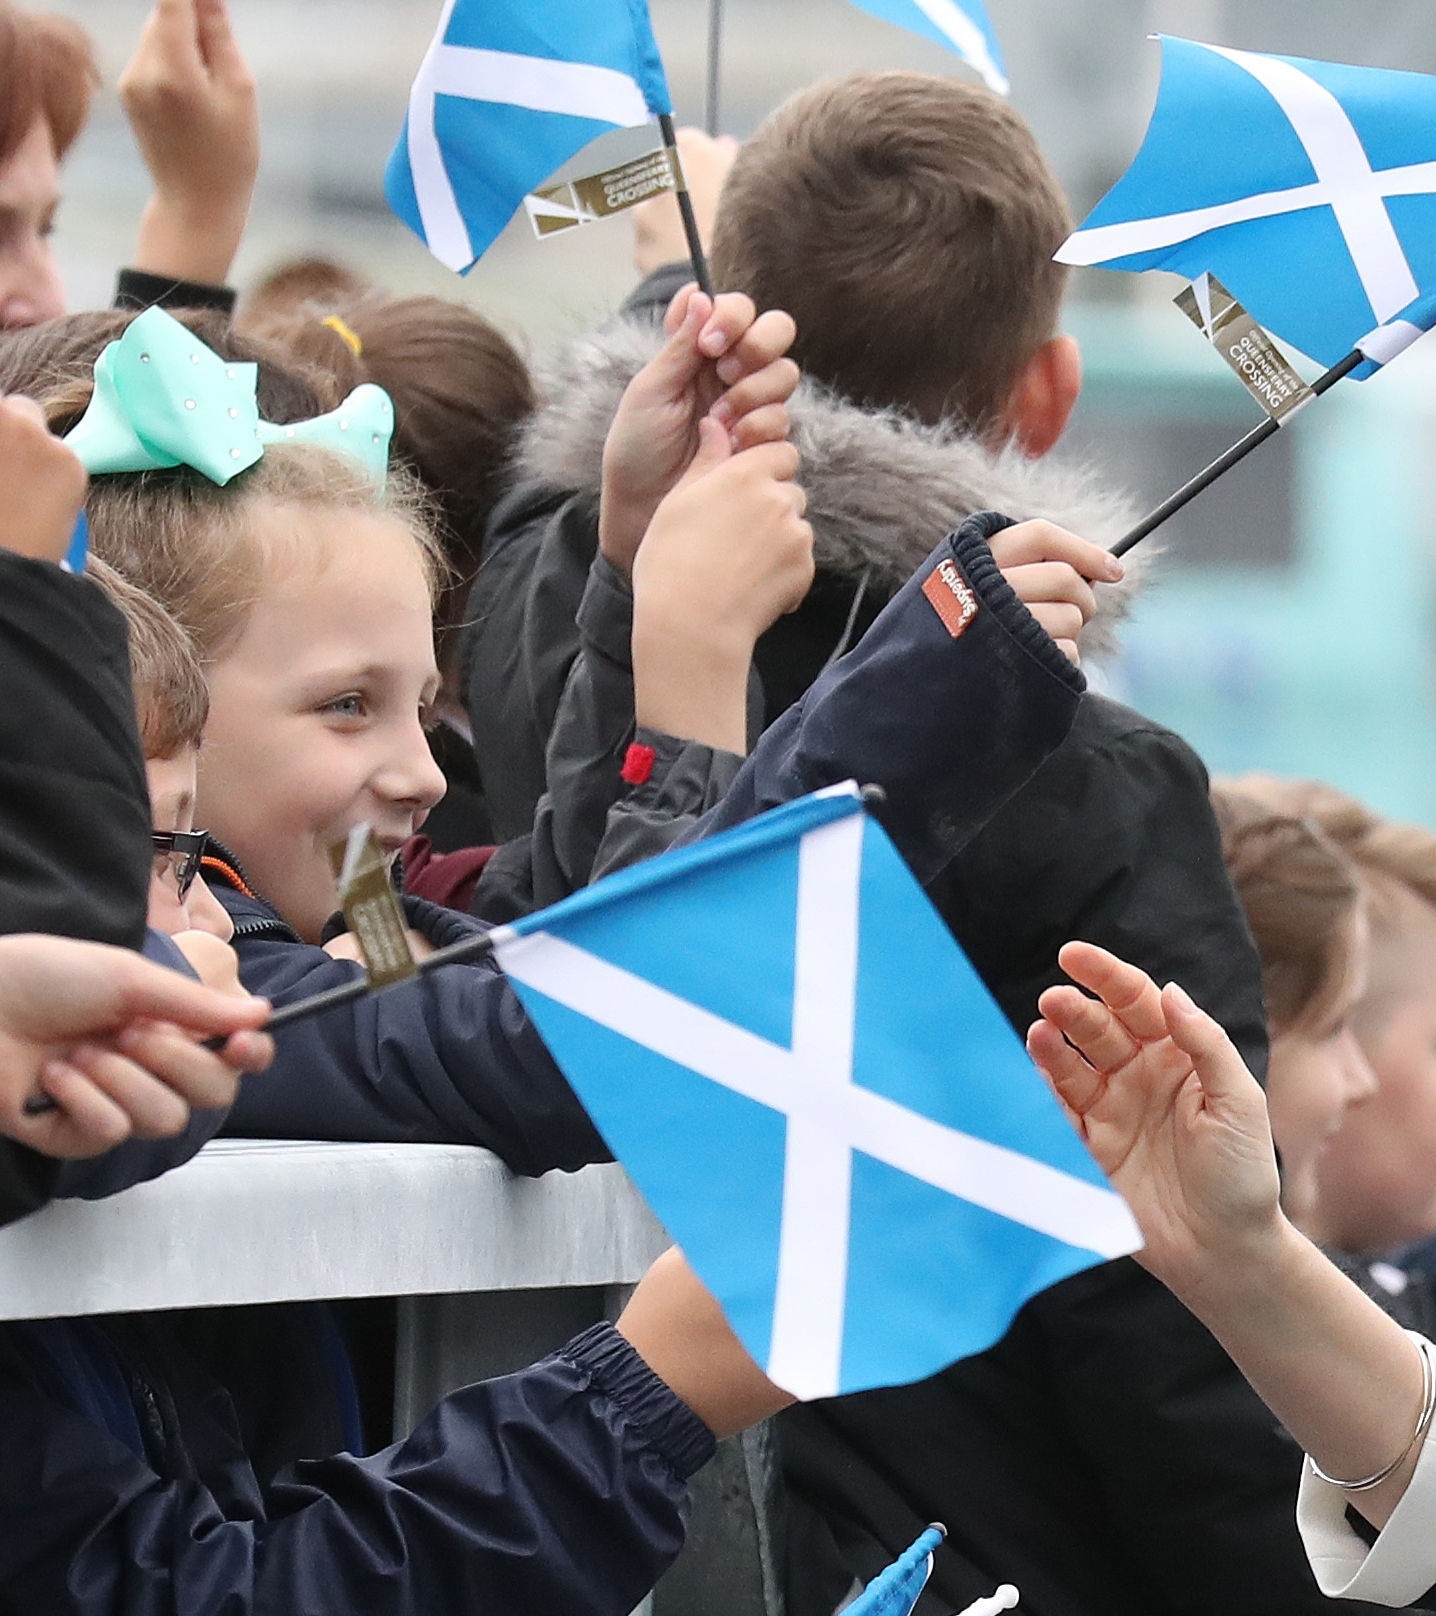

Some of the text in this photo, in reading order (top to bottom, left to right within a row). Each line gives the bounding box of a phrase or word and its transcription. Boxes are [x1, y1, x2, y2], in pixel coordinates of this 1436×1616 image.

[607, 173, 675, 208] CROSSING
[1230, 345, 1284, 408] CROSSING
[1240, 337, 1293, 397] QUEENSFERRY
[936, 559, 978, 617] Superdry
